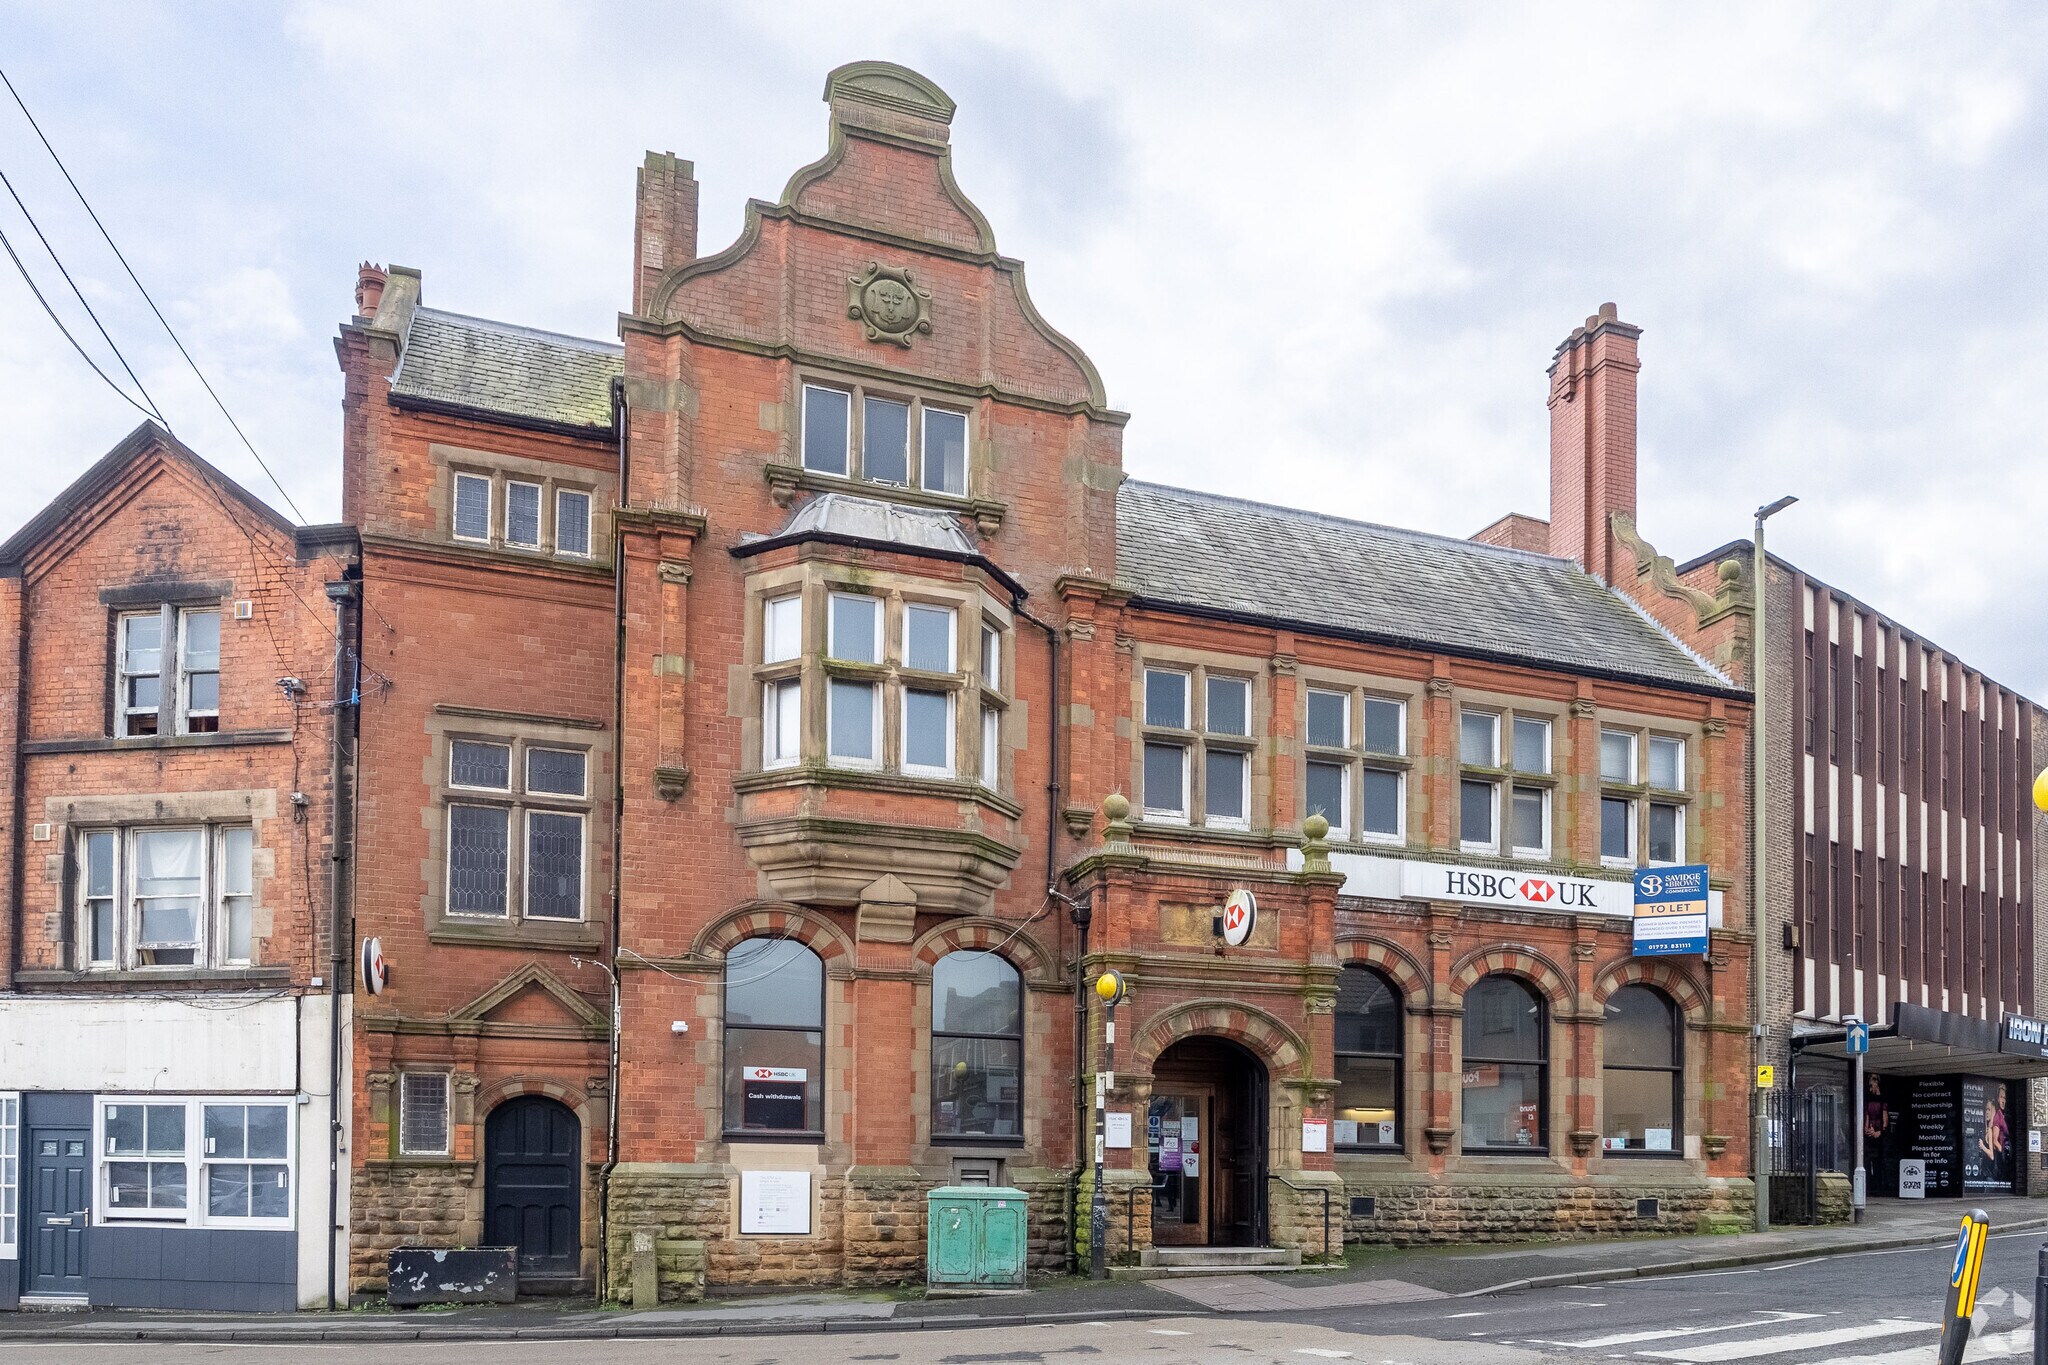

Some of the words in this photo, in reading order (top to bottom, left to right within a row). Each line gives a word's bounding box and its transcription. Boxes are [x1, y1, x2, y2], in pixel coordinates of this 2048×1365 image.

[1665, 873, 1700, 882] SAVIDGE
[1669, 880, 1700, 888] BROWN
[1445, 870, 1516, 900] HSBC
[1557, 881, 1598, 908] UK
[1650, 905, 1666, 913] TO
[1670, 904, 1690, 912] LET
[2007, 1017, 2042, 1044] IRON
[1911, 1101, 1953, 1109] Membership
